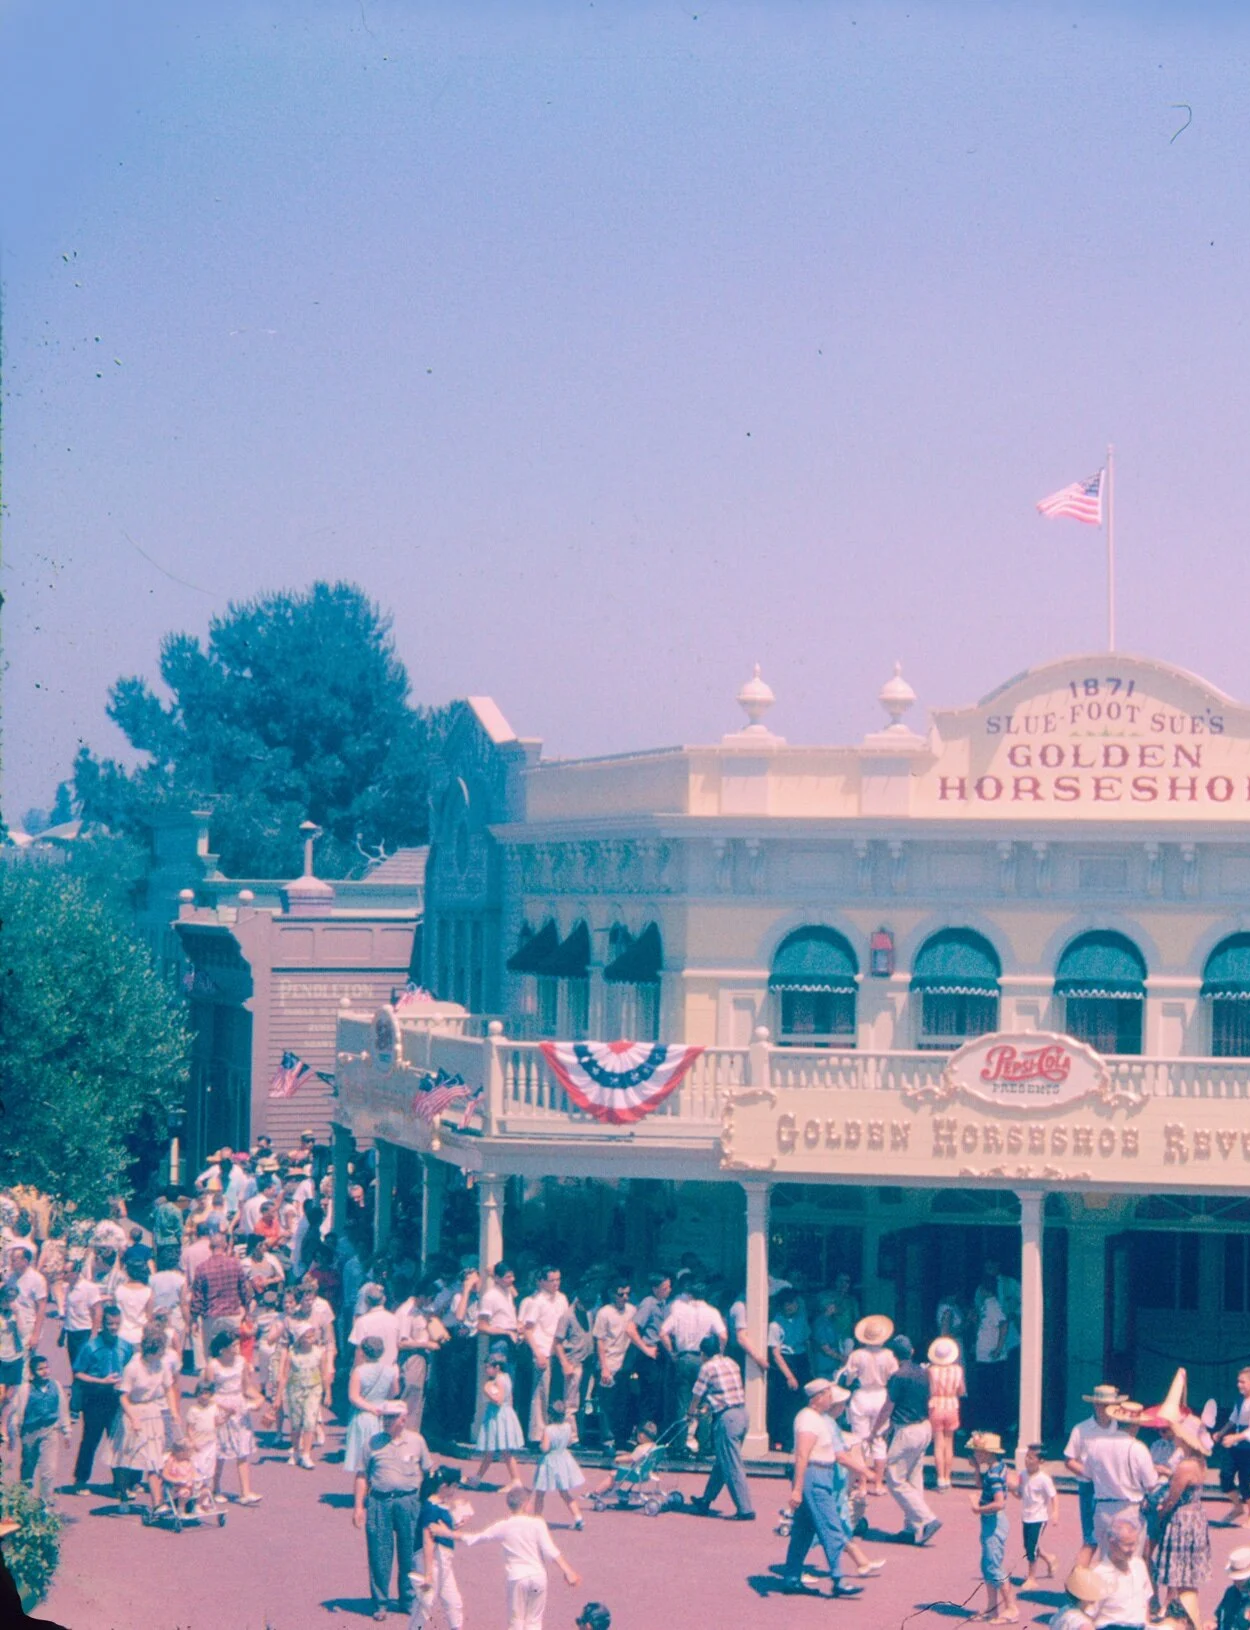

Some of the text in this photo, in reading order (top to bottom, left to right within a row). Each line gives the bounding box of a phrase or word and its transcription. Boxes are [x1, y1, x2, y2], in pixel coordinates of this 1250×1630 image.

[1069, 677, 1136, 698] 1871
[1150, 708, 1225, 735] SUE'S
[1007, 743, 1203, 769] GOLDEN
[992, 1083, 1061, 1095] PRESENTS
[776, 1112, 911, 1155] GOLDEN
[931, 1117, 1140, 1159] HORSESHOE
